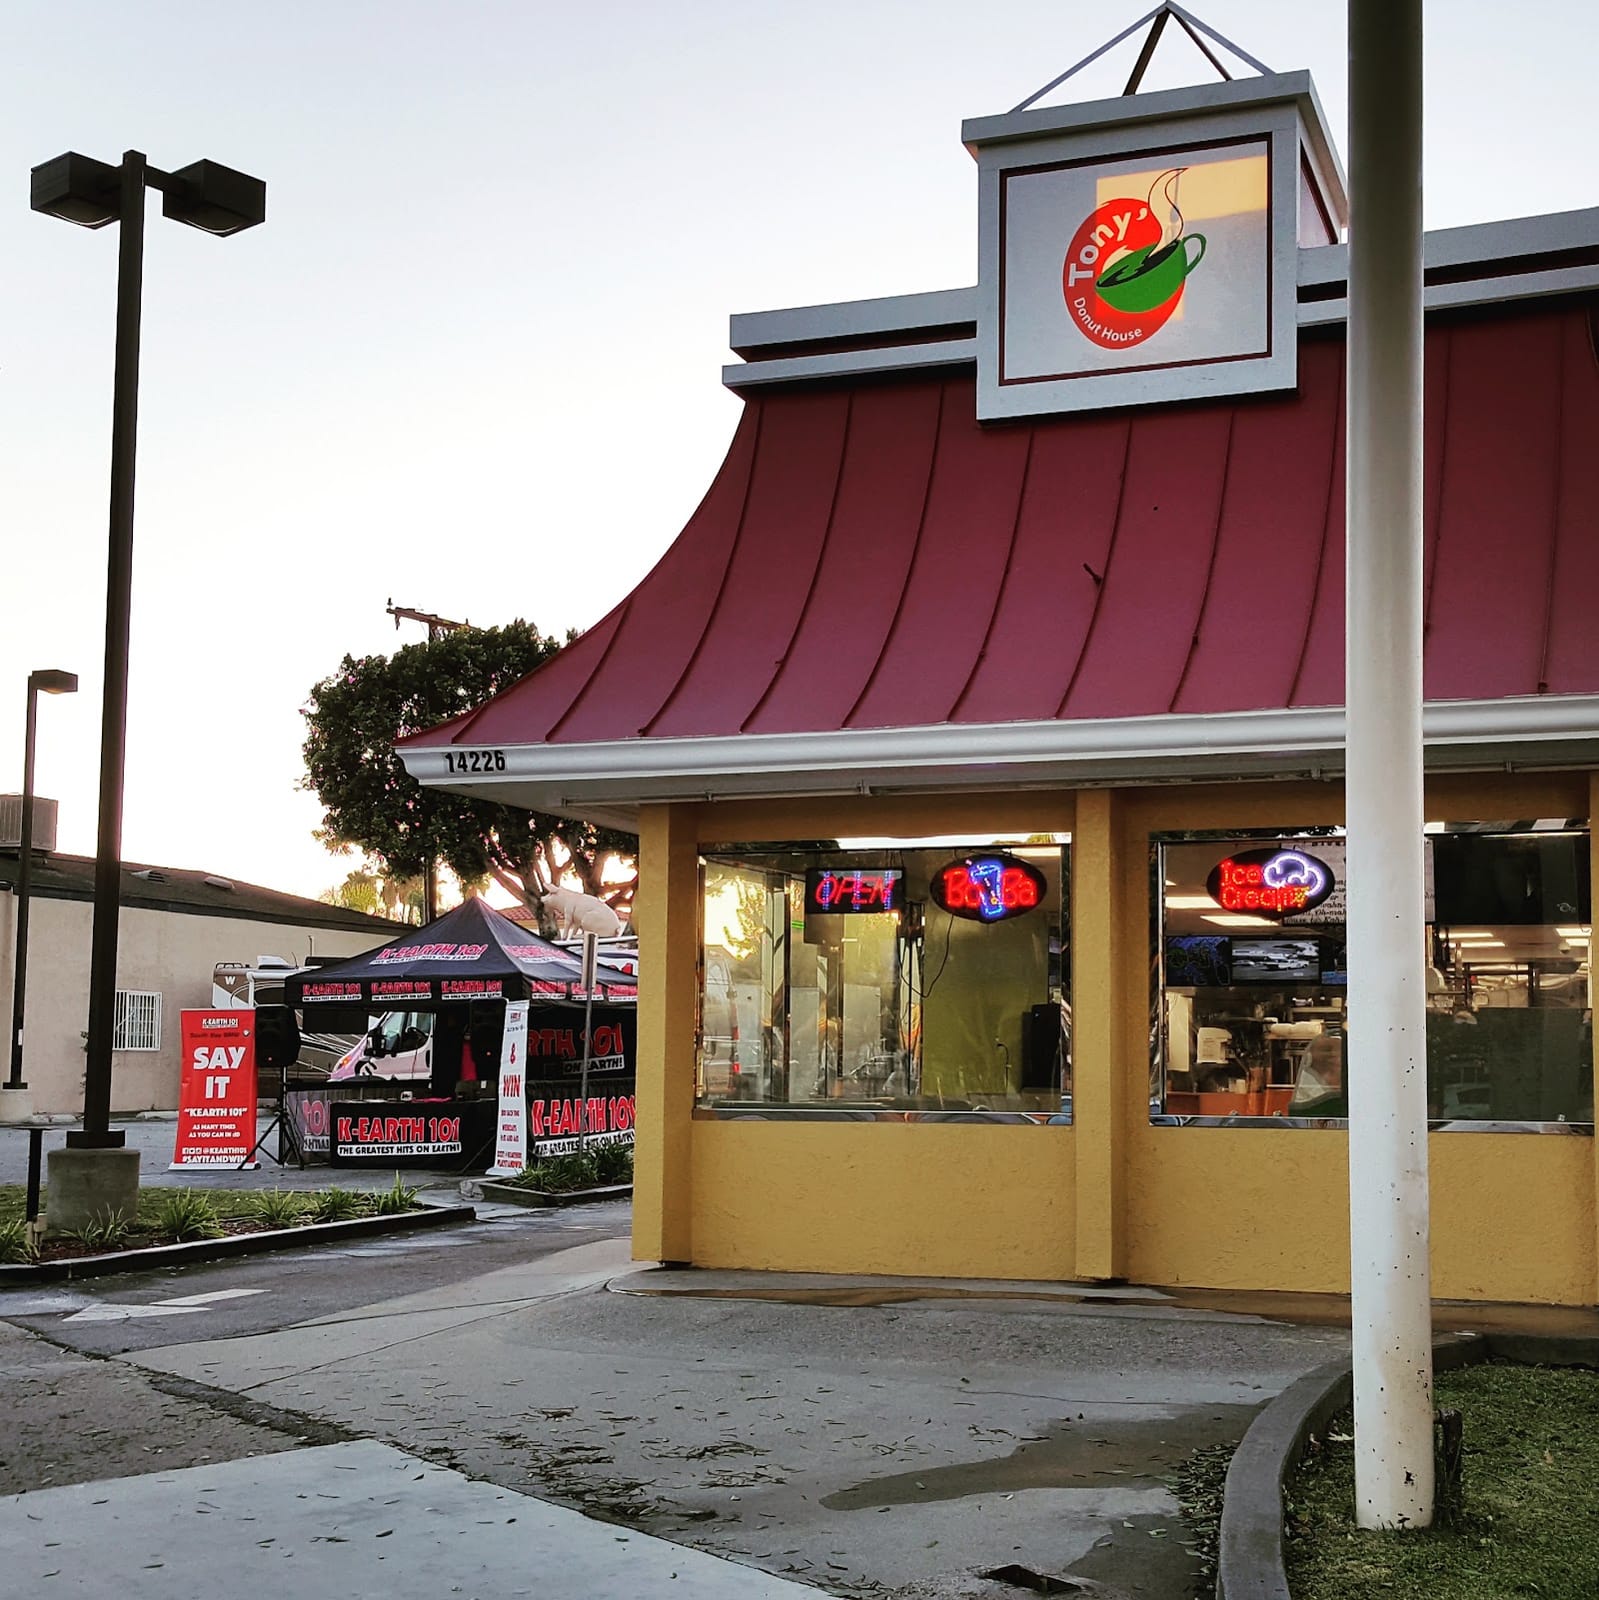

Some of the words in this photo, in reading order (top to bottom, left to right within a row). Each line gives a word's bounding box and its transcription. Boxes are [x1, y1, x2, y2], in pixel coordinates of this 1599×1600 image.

[1074, 297, 1101, 335] Donut
[1101, 327, 1143, 342] House
[445, 750, 505, 773] 14226
[1220, 858, 1260, 886] Ice
[815, 876, 895, 905] OPEN
[376, 944, 457, 959] K-EARTH
[456, 944, 488, 956] 101
[224, 975, 236, 985] W
[303, 983, 344, 996] K-EARTH
[345, 982, 361, 994] 101
[486, 980, 502, 992] 101
[193, 1046, 246, 1070] SAY
[584, 1056, 623, 1071] ARTH!
[205, 1075, 230, 1099] IT
[503, 1074, 521, 1097] WIN
[532, 1098, 606, 1136] K-EARTH
[337, 1116, 425, 1143] K-EARTH
[429, 1116, 460, 1143] 101
[339, 1146, 354, 1154] THE
[355, 1146, 394, 1155] GREATEST
[396, 1145, 414, 1154] HITS
[416, 1144, 430, 1153] ON
[432, 1143, 460, 1153] EARTH!
